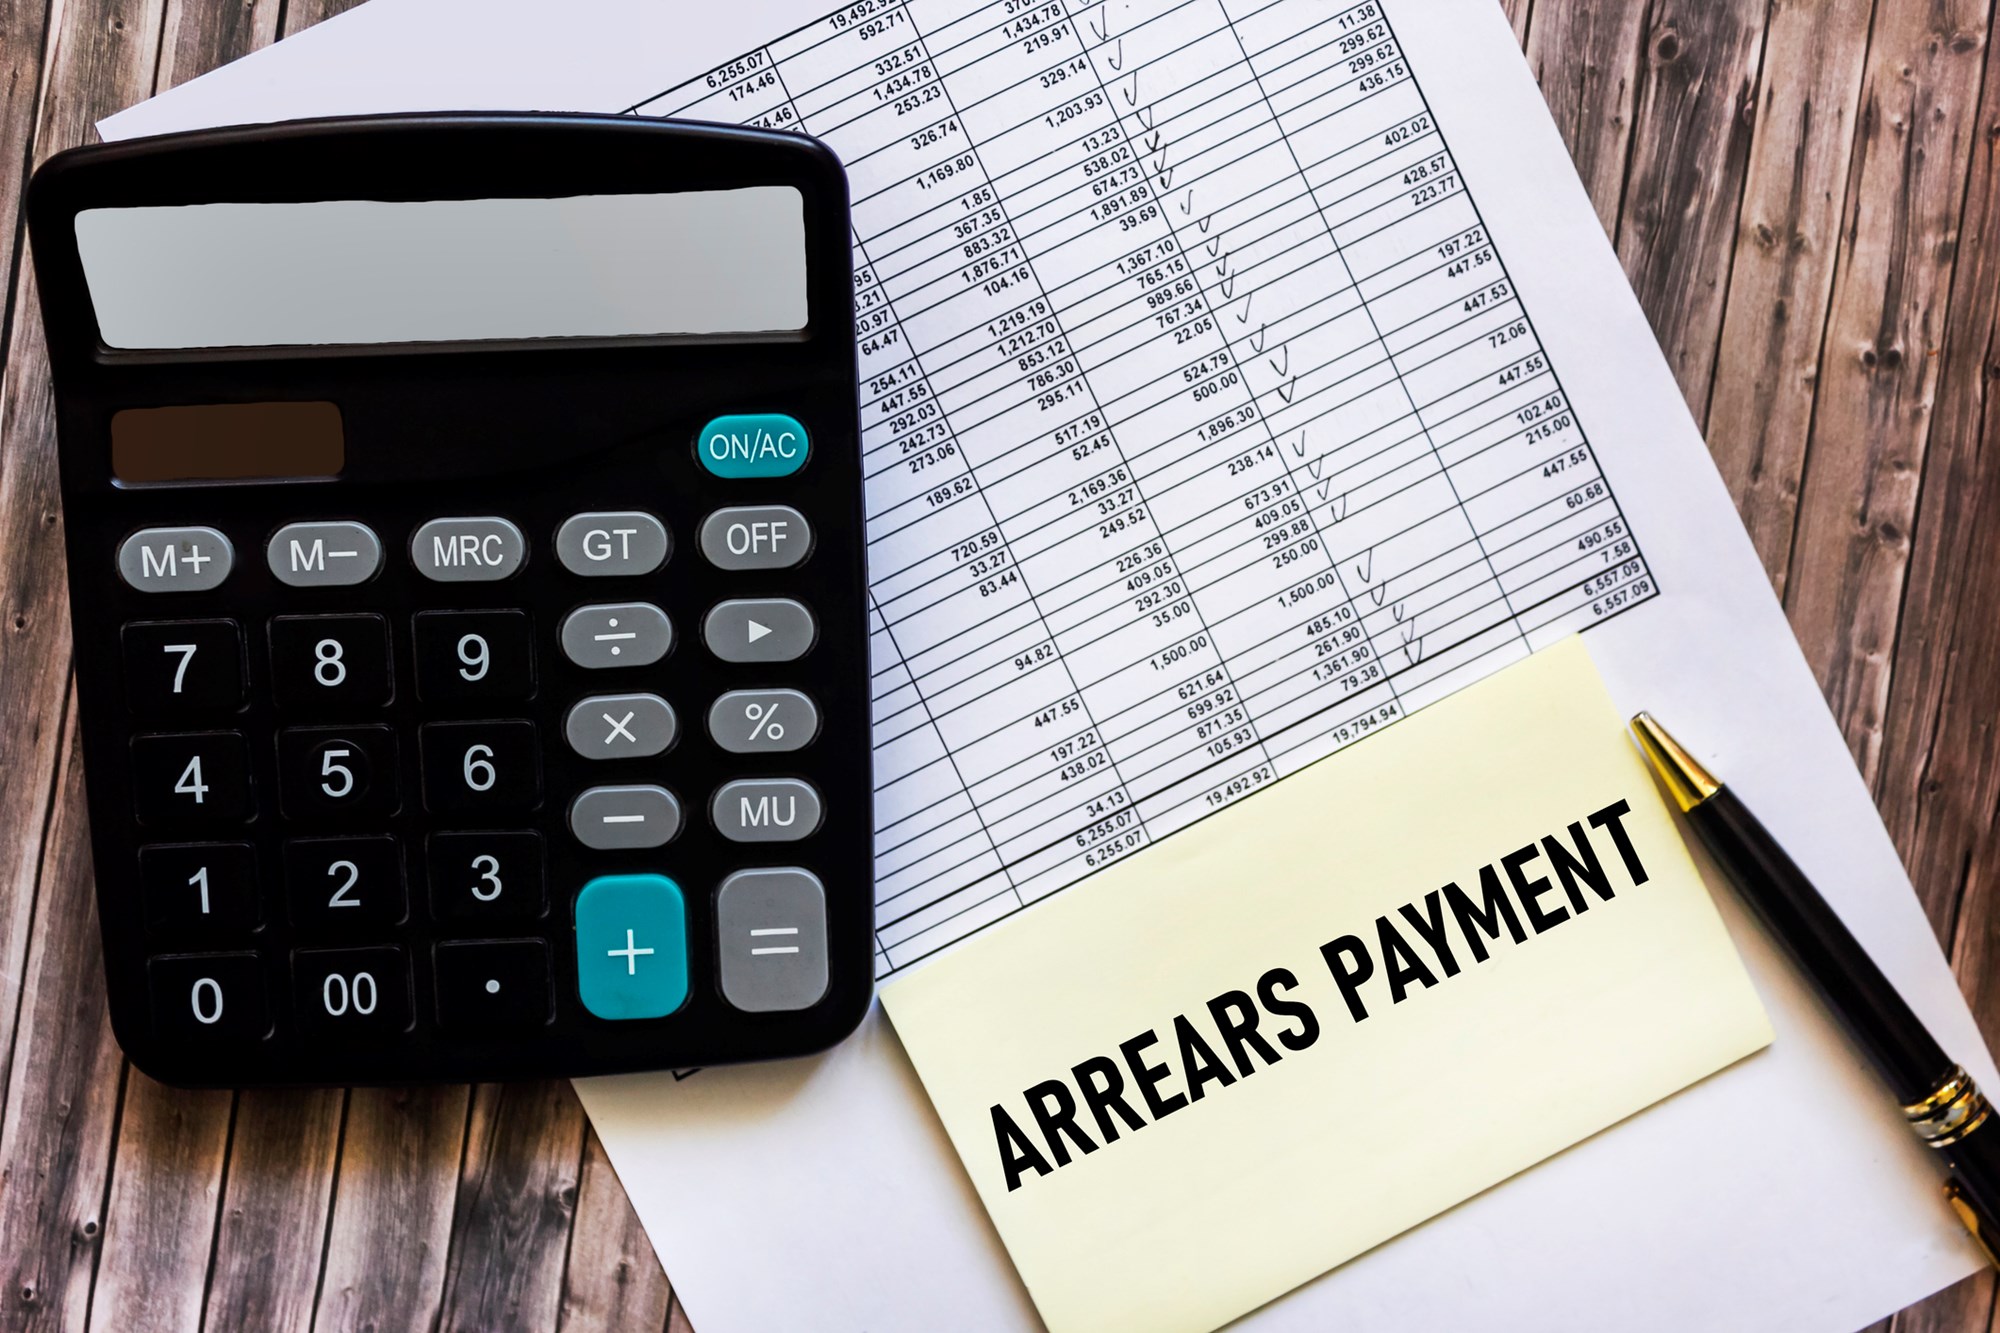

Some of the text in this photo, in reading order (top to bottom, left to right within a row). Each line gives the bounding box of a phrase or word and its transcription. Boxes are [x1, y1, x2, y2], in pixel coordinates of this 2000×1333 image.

[858, 10, 905, 41] 592.71
[1002, 3, 1061, 39] 1,434.78
[1338, 4, 1376, 30] 11.38
[1023, 23, 1070, 55] 219.91
[1338, 23, 1386, 55] 299.62
[706, 51, 764, 89] 6,255.07
[874, 45, 922, 76] 332.51
[1039, 58, 1087, 89] 329.14
[1348, 43, 1395, 74] 299.62
[728, 71, 776, 102] 174.46
[872, 65, 932, 101] 1,434.78
[1359, 62, 1404, 92] 436.15
[893, 85, 941, 117] 253.23
[1045, 92, 1104, 128] 1,203.93
[910, 119, 958, 151] 326.74
[1081, 127, 1120, 153] 13.23
[1384, 116, 1430, 146] 402.02
[916, 154, 975, 190] 1,169.80
[1083, 146, 1130, 177] 538.02
[1403, 155, 1446, 185] 428.57
[1092, 166, 1139, 197] 674.73
[1411, 175, 1455, 207] 223.77
[960, 188, 992, 211] 1.85
[1090, 185, 1148, 221] 1,891.89
[953, 207, 1001, 239] 367.35
[1118, 205, 1158, 232] 39.69
[963, 227, 1011, 259] 883.32
[1116, 239, 1175, 275] 1,367.10
[1437, 229, 1484, 259] 197.22
[961, 247, 1020, 283] 1,876.71
[1136, 258, 1184, 290] 765.15
[1447, 248, 1492, 278] 447.55
[983, 266, 1030, 297] 104.16
[1146, 278, 1194, 309] 989.66
[1463, 283, 1509, 312] 447.53
[987, 301, 1046, 337] 1,219.19
[1155, 298, 1203, 329] 767.34
[997, 320, 1056, 357] 1,212.70
[1173, 317, 1213, 345] 22.05
[1488, 322, 1527, 349] 72.06
[1017, 340, 1066, 372] 853.12
[1183, 352, 1229, 383] 524.79
[1498, 356, 1543, 385] 447.55
[869, 363, 917, 397] 254.11
[1026, 360, 1075, 392] 786.30
[1192, 372, 1239, 403] 500.00
[881, 382, 927, 414] 447.55
[1037, 379, 1084, 412] 295.11
[1516, 395, 1562, 425] 102.40
[889, 403, 937, 435] 292.03
[1054, 414, 1101, 446] 517.19
[1197, 406, 1255, 442] 1,896.30
[1525, 415, 1571, 446] 215.00
[710, 429, 796, 463] ON/AC
[898, 422, 946, 455] 242.73
[1072, 434, 1111, 461] 52.45
[908, 442, 956, 474] 273.06
[1227, 445, 1274, 477] 238.14
[1543, 448, 1588, 478] 447.55
[925, 477, 973, 507] 189.62
[1067, 468, 1127, 506] 2,169.36
[1097, 487, 1134, 515] 33.27
[1244, 479, 1290, 510] 673.91
[1565, 482, 1604, 509] 60.68
[1099, 507, 1147, 539] 249.52
[1255, 498, 1300, 529] 409.05
[583, 530, 637, 560] GT
[727, 522, 787, 554] OFF
[950, 531, 999, 562] 720.59
[1262, 518, 1310, 550] 299.88
[1578, 521, 1623, 551] 490.55
[142, 545, 211, 577] M+
[434, 535, 503, 567] MRC
[969, 550, 1006, 578] 33.27
[1115, 542, 1163, 574] 226.36
[1272, 538, 1319, 569] 250.00
[1600, 541, 1632, 564] 7.58
[978, 570, 1018, 598] 83.44
[1127, 561, 1172, 591] 409.05
[1277, 572, 1335, 608] 1,500.00
[1583, 560, 1642, 598] 6,557.09
[1134, 581, 1181, 613] 292.30
[1592, 580, 1650, 616] 6,557.09
[1152, 601, 1191, 628] 35.00
[1306, 606, 1351, 636] 485.10
[458, 634, 490, 680] 9
[1014, 643, 1054, 671] 94.82
[1150, 635, 1208, 671] 1,500.00
[1314, 626, 1361, 658] 261.90
[164, 645, 197, 692] 7
[315, 639, 346, 686] 8
[1312, 645, 1370, 681] 1,361.90
[1340, 665, 1379, 692] 79.38
[1177, 669, 1224, 700] 621.64
[1034, 697, 1080, 728] 447.55
[1187, 688, 1234, 720] 699.92
[1196, 708, 1243, 739] 871.35
[1332, 704, 1398, 743] 19,794.94
[1050, 732, 1097, 762] 197.22
[1206, 728, 1252, 758] 105.93
[175, 756, 209, 803] 4
[322, 750, 353, 796] 5
[464, 745, 496, 790] 6
[1060, 751, 1107, 782] 438.02
[1205, 767, 1271, 807] 19,492.92
[741, 796, 796, 826] MU
[1085, 791, 1125, 818] 34.13
[1075, 810, 1133, 849] 6,255.07
[1085, 829, 1141, 867] 6,255.07
[188, 867, 210, 913] 1
[328, 861, 361, 907] 2
[471, 855, 502, 900] 3
[192, 978, 223, 1023] 0
[324, 973, 377, 1015] 00
[990, 798, 1649, 1192] ARREARS PAYMENT
